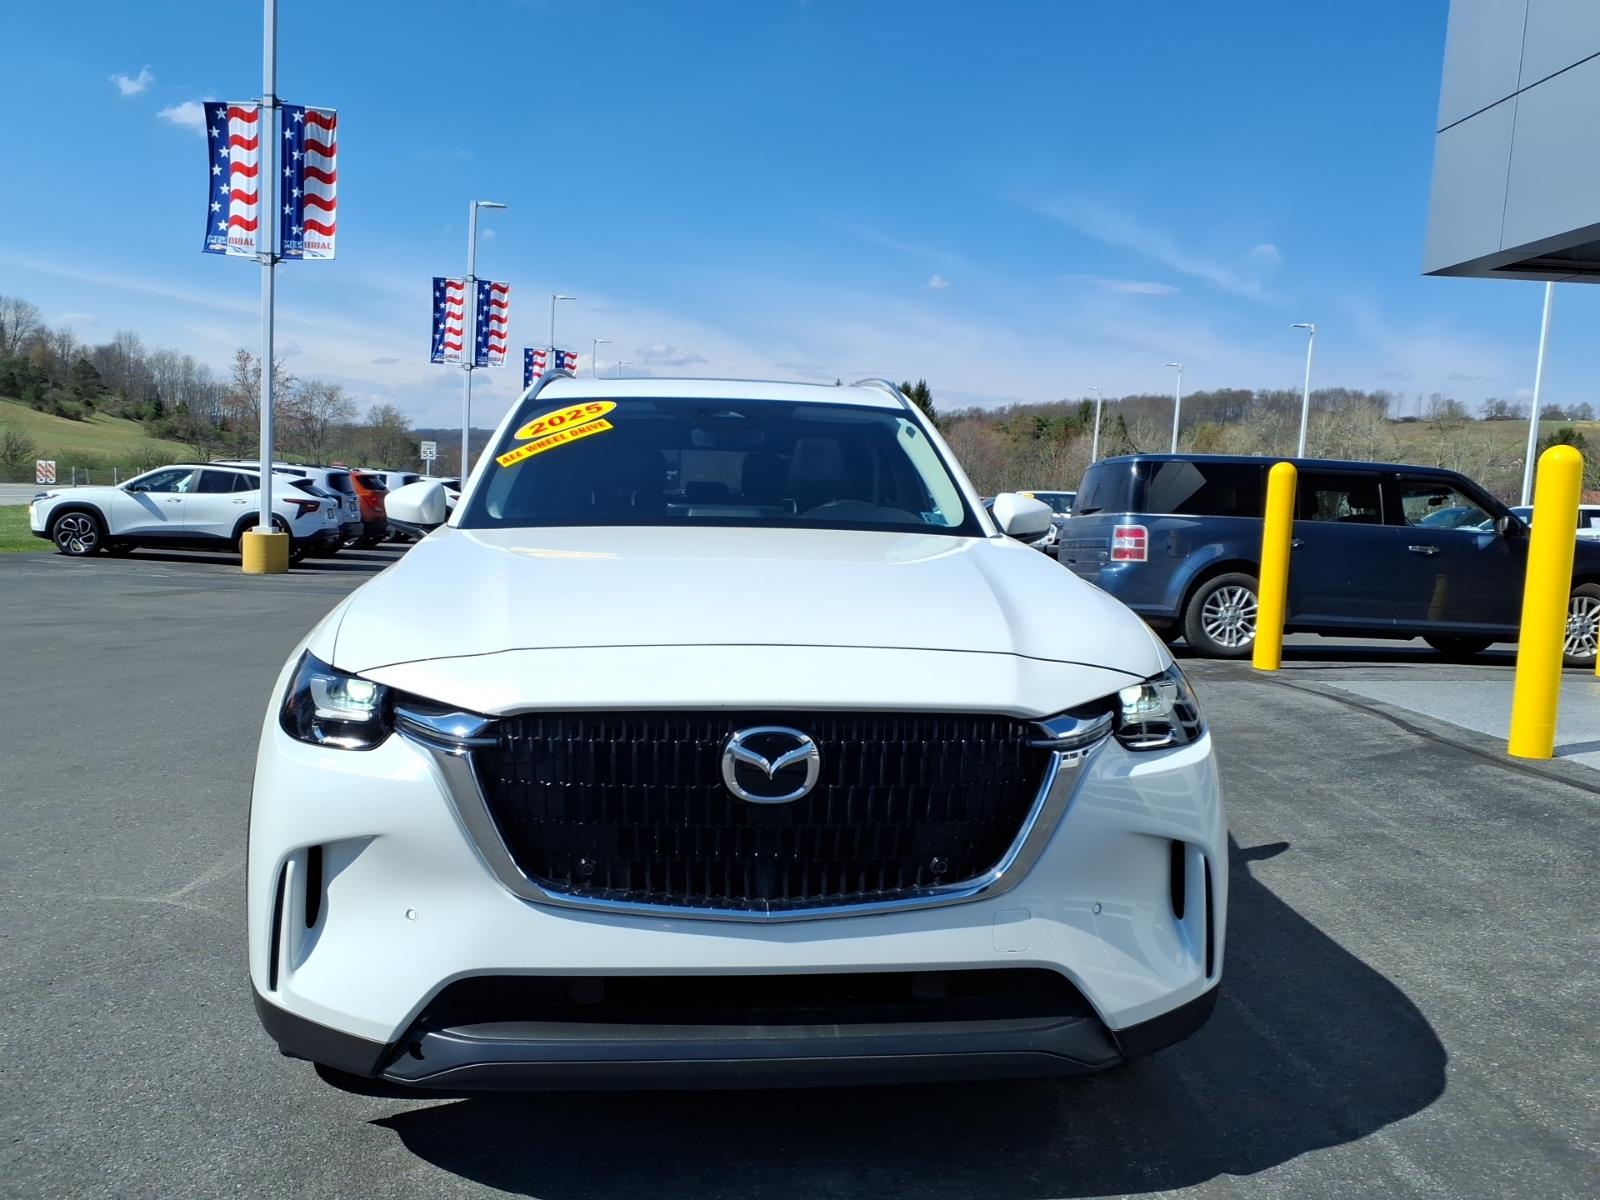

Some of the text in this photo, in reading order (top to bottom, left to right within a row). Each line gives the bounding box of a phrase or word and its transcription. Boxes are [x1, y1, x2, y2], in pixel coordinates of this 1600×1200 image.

[528, 403, 603, 436] 2025
[502, 420, 609, 464] ALL WHEEL DRIVE
